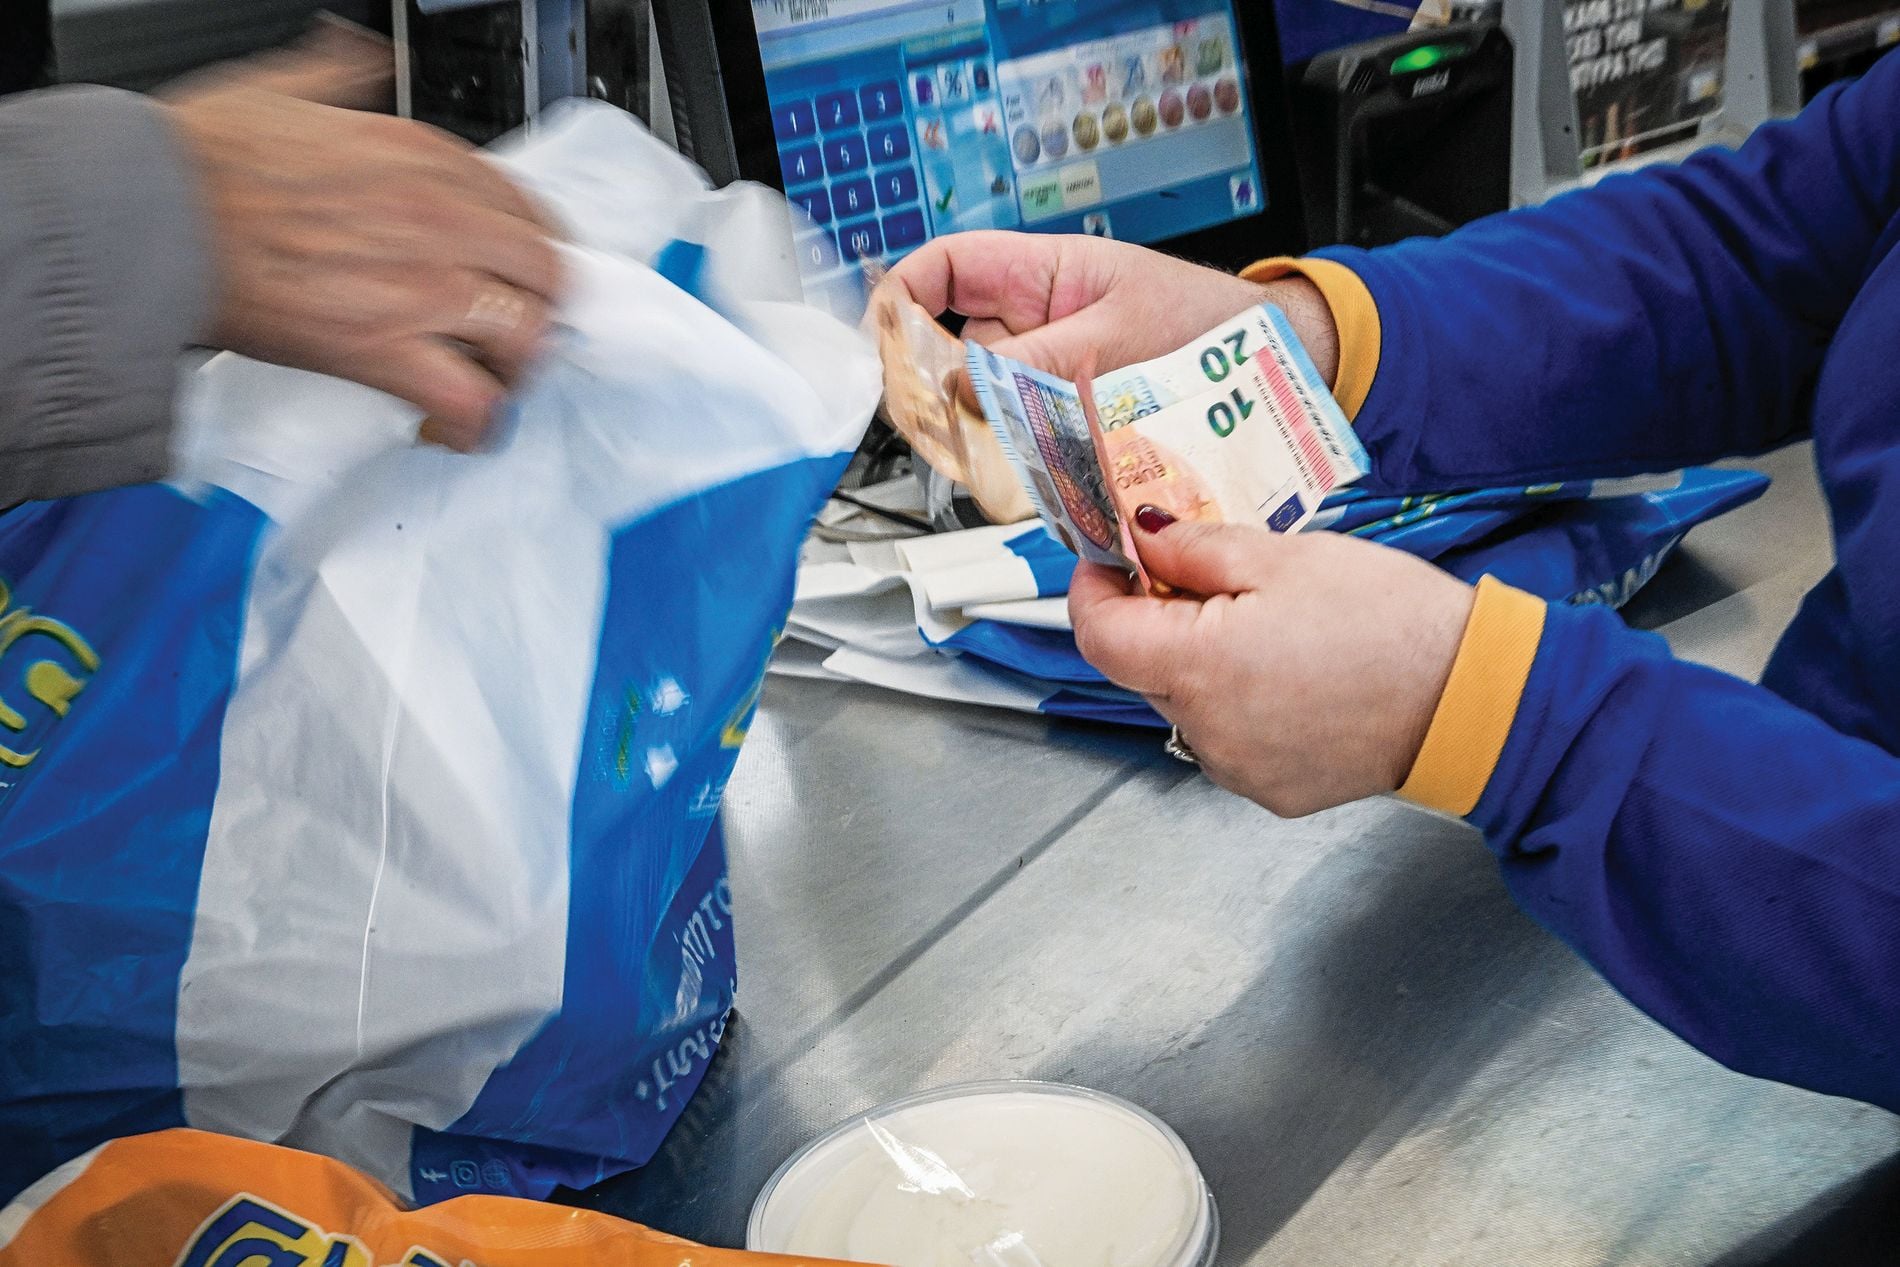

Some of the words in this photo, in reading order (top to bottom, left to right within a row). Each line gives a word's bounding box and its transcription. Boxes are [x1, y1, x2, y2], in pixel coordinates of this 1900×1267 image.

[790, 111, 797, 133] 1
[832, 101, 842, 125] 2
[876, 90, 886, 113] 3
[797, 155, 806, 178] 4
[840, 144, 850, 168] 5
[884, 133, 894, 156] 6
[848, 187, 858, 210] 8
[891, 176, 901, 198] 9
[812, 244, 821, 265] 0
[851, 230, 870, 252] 00
[1200, 328, 1249, 383] 20
[1207, 387, 1255, 438] 10
